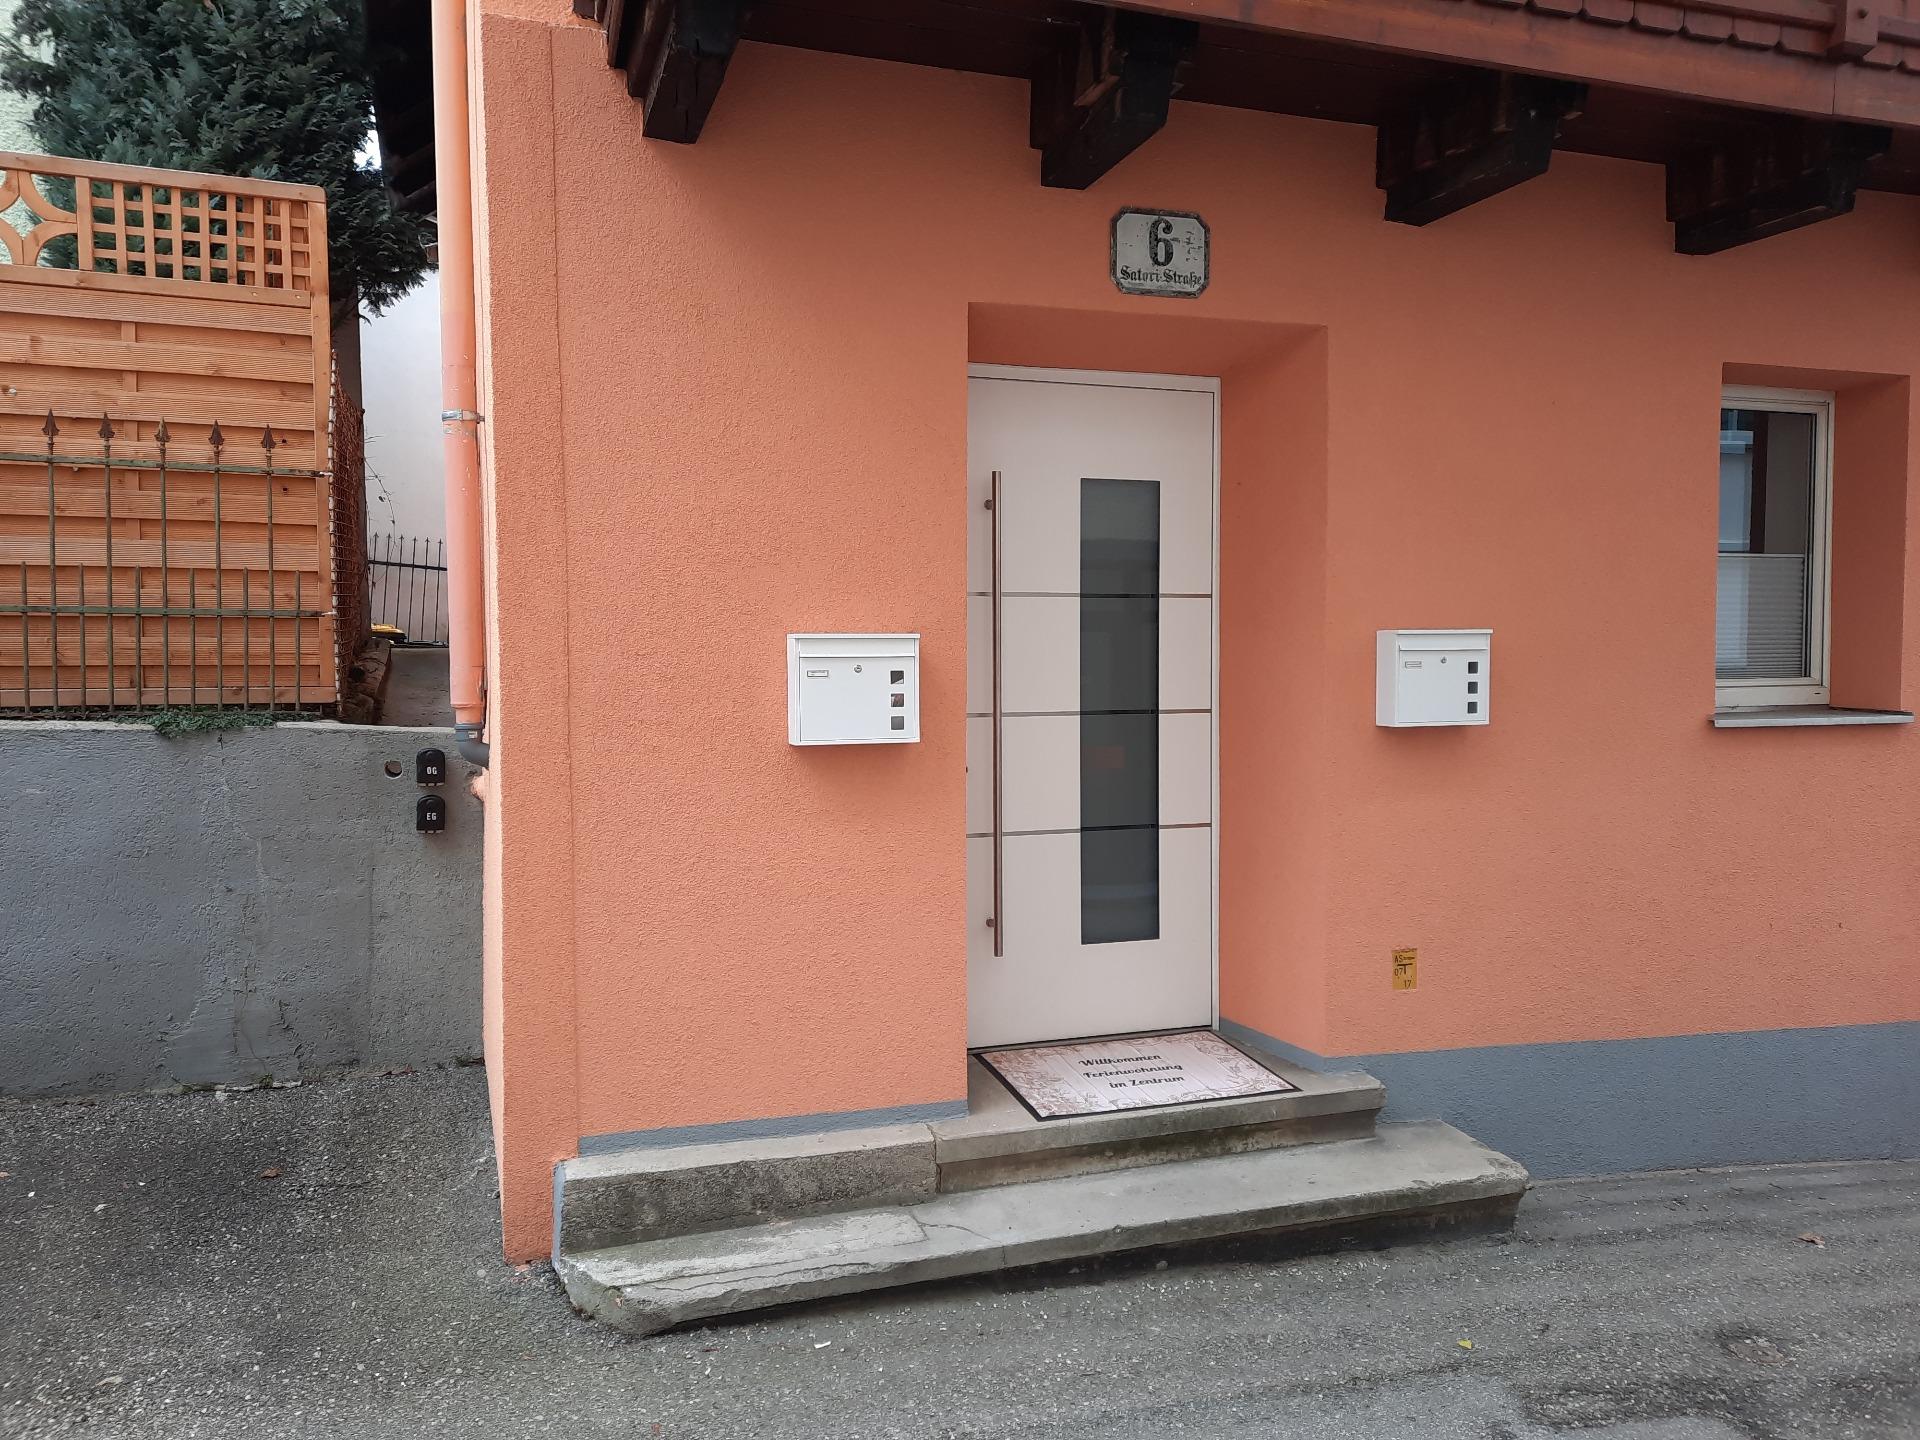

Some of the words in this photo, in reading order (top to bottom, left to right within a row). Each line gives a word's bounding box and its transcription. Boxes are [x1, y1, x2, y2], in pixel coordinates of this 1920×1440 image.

[1149, 216, 1173, 267] 6
[426, 812, 437, 821] EG
[1078, 1054, 1162, 1067] Willkommen
[1082, 1064, 1183, 1079] Ferienwohnung
[1109, 1081, 1128, 1089] im
[1129, 1075, 1185, 1087] Zentrum
